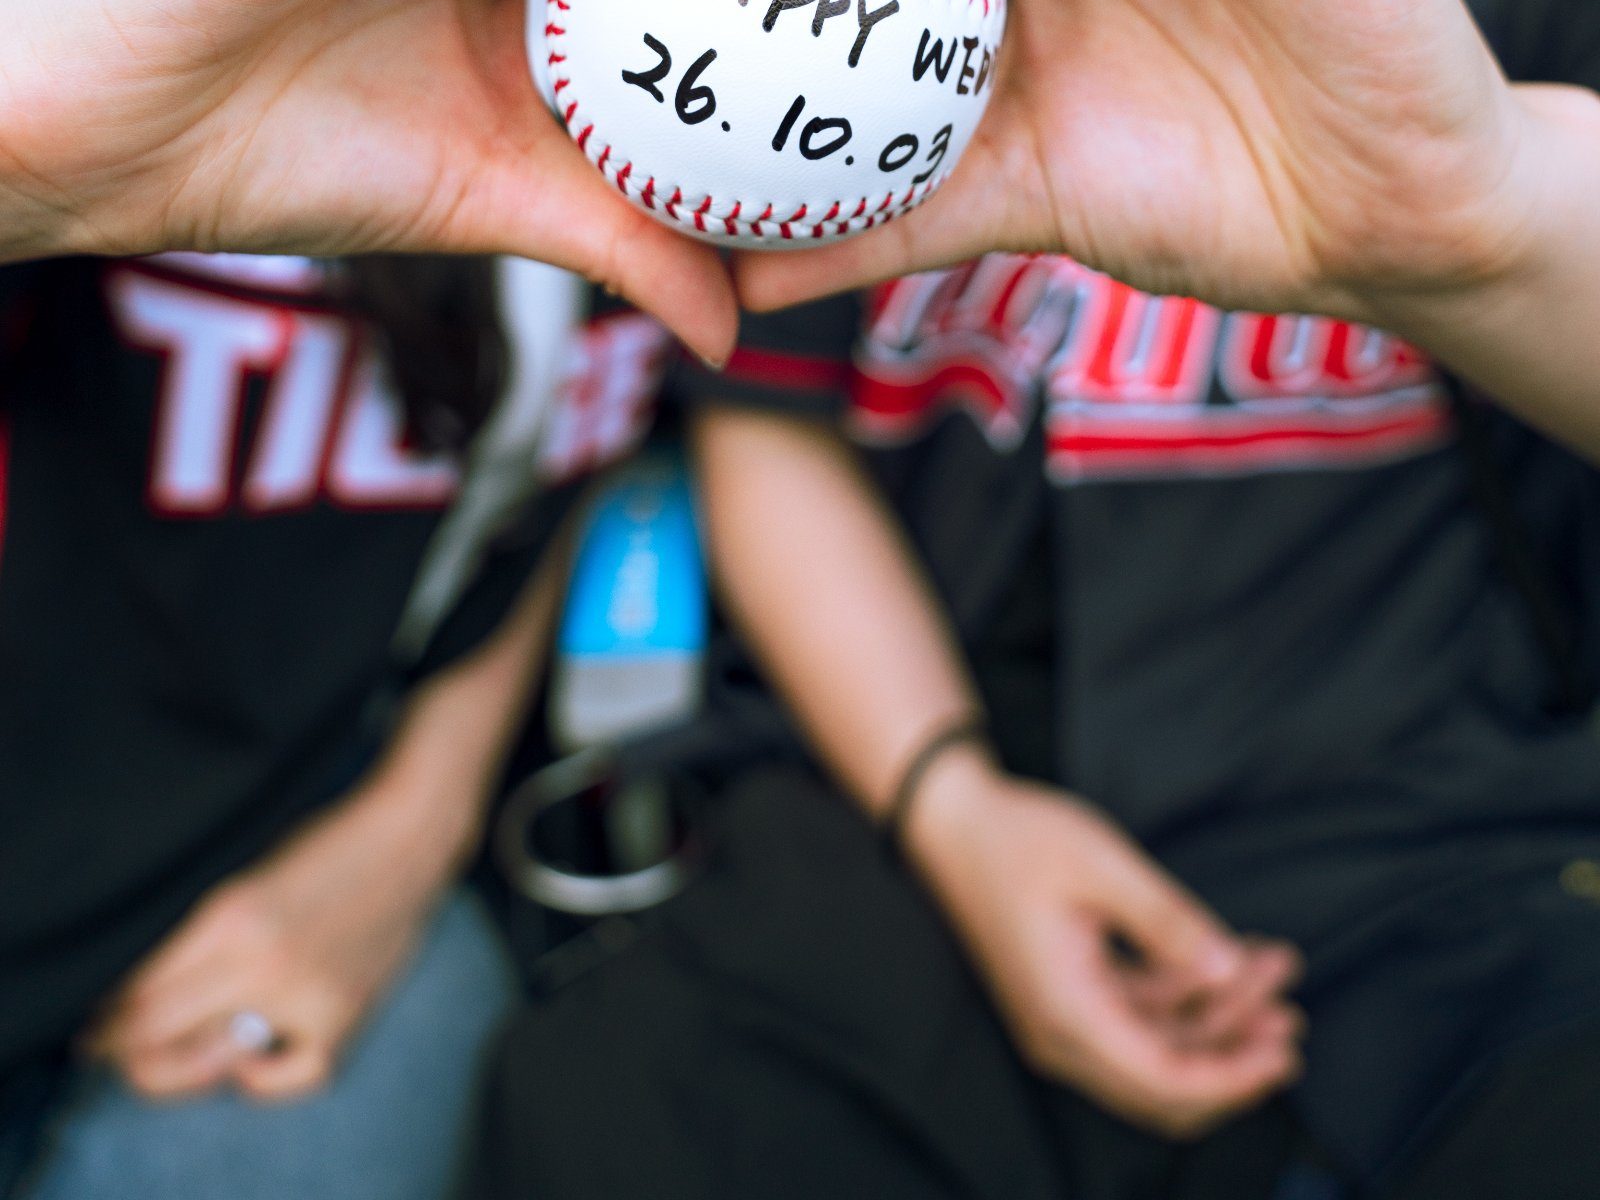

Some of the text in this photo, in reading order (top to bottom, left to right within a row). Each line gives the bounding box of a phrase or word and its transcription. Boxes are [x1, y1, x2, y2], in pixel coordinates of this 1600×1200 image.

[621, 32, 953, 185] 26. 10. 03
[912, 27, 997, 96] WED
